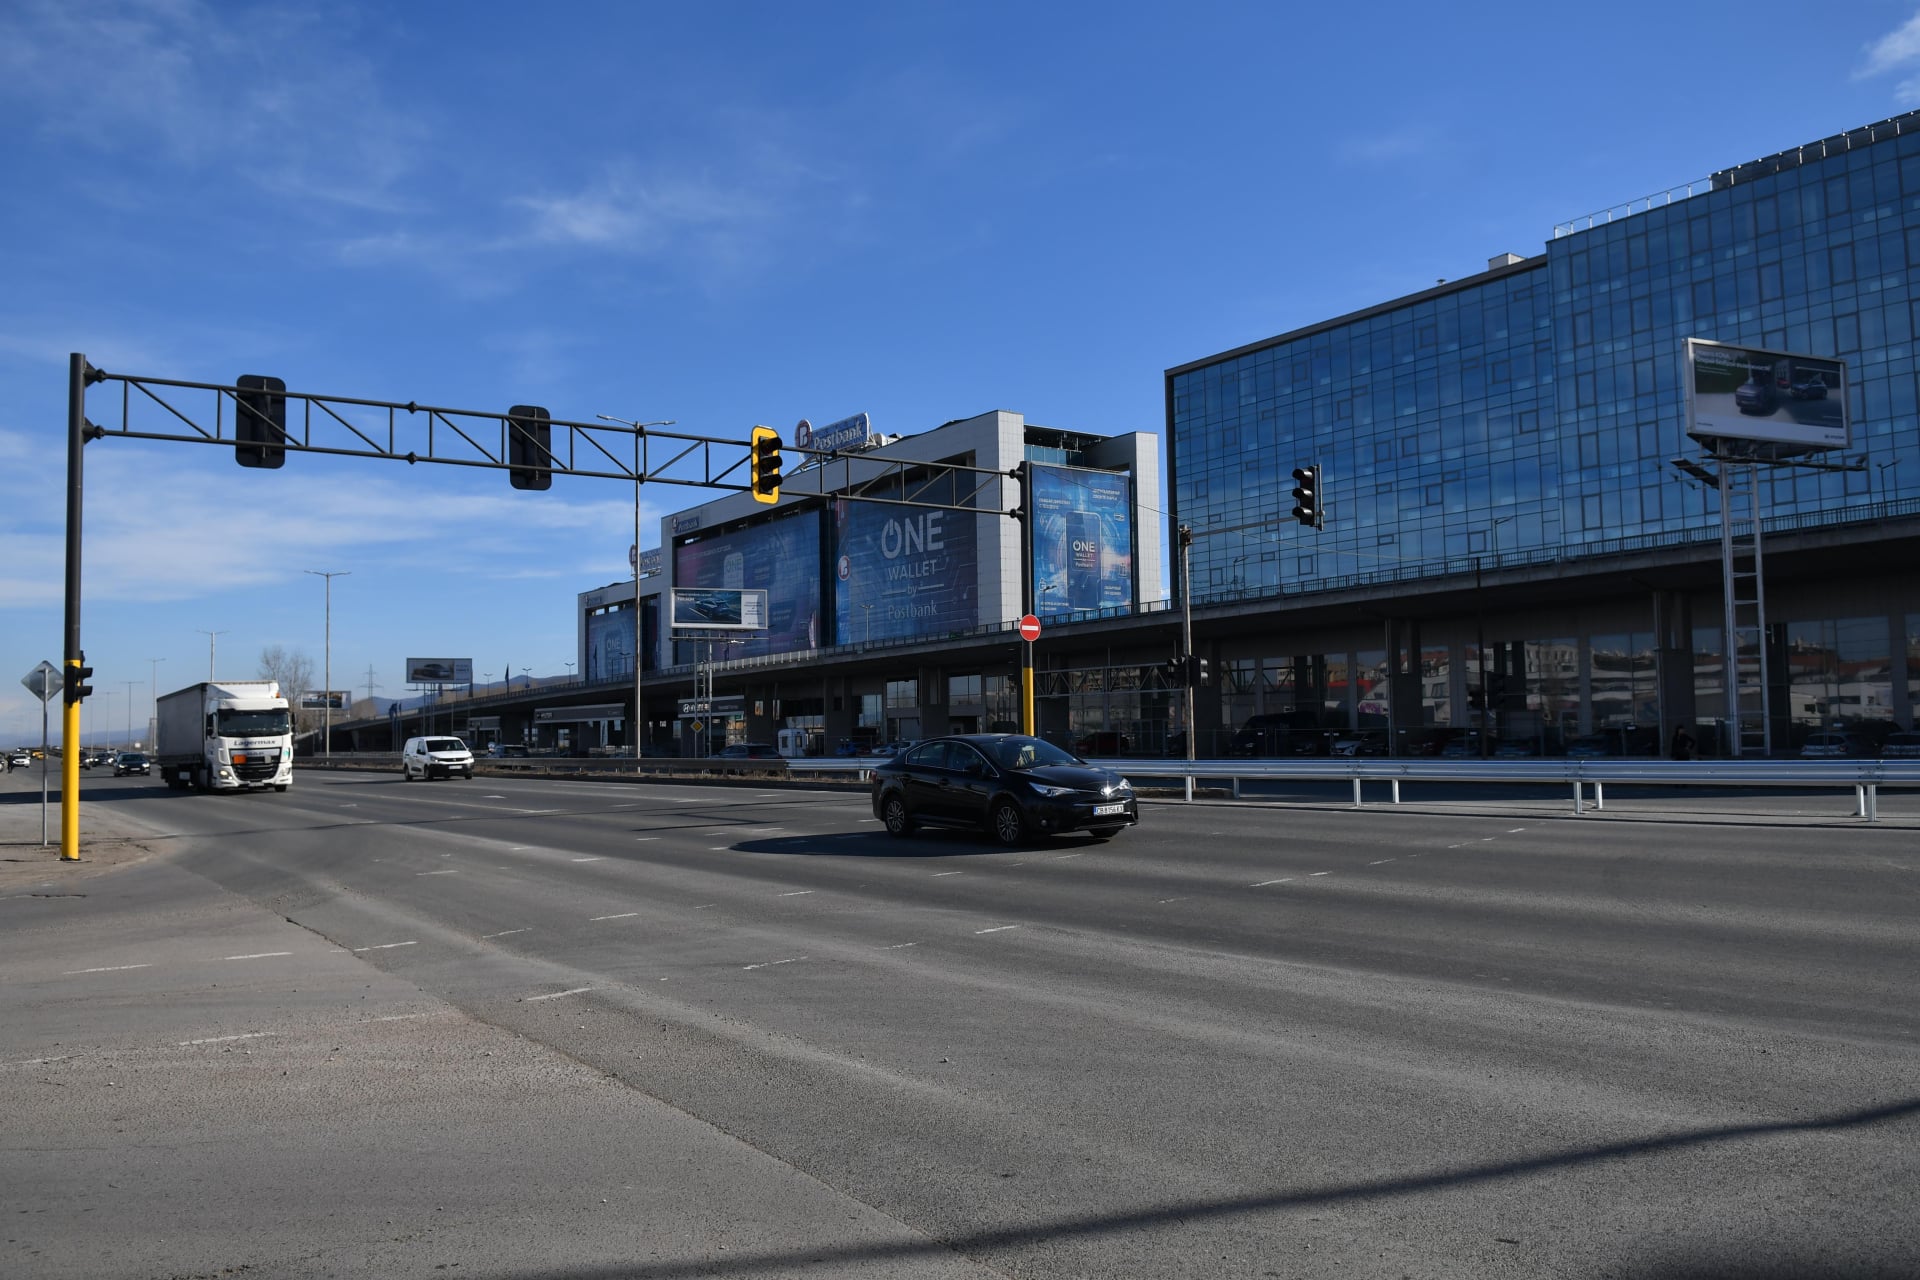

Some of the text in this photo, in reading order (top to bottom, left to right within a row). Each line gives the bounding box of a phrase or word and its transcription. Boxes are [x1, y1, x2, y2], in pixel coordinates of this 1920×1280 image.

[814, 421, 864, 450] Postbank
[881, 510, 944, 559] ONE
[1072, 540, 1096, 553] ONE
[888, 559, 937, 580] WALLET
[907, 584, 918, 597] by
[888, 600, 937, 620] Postbank
